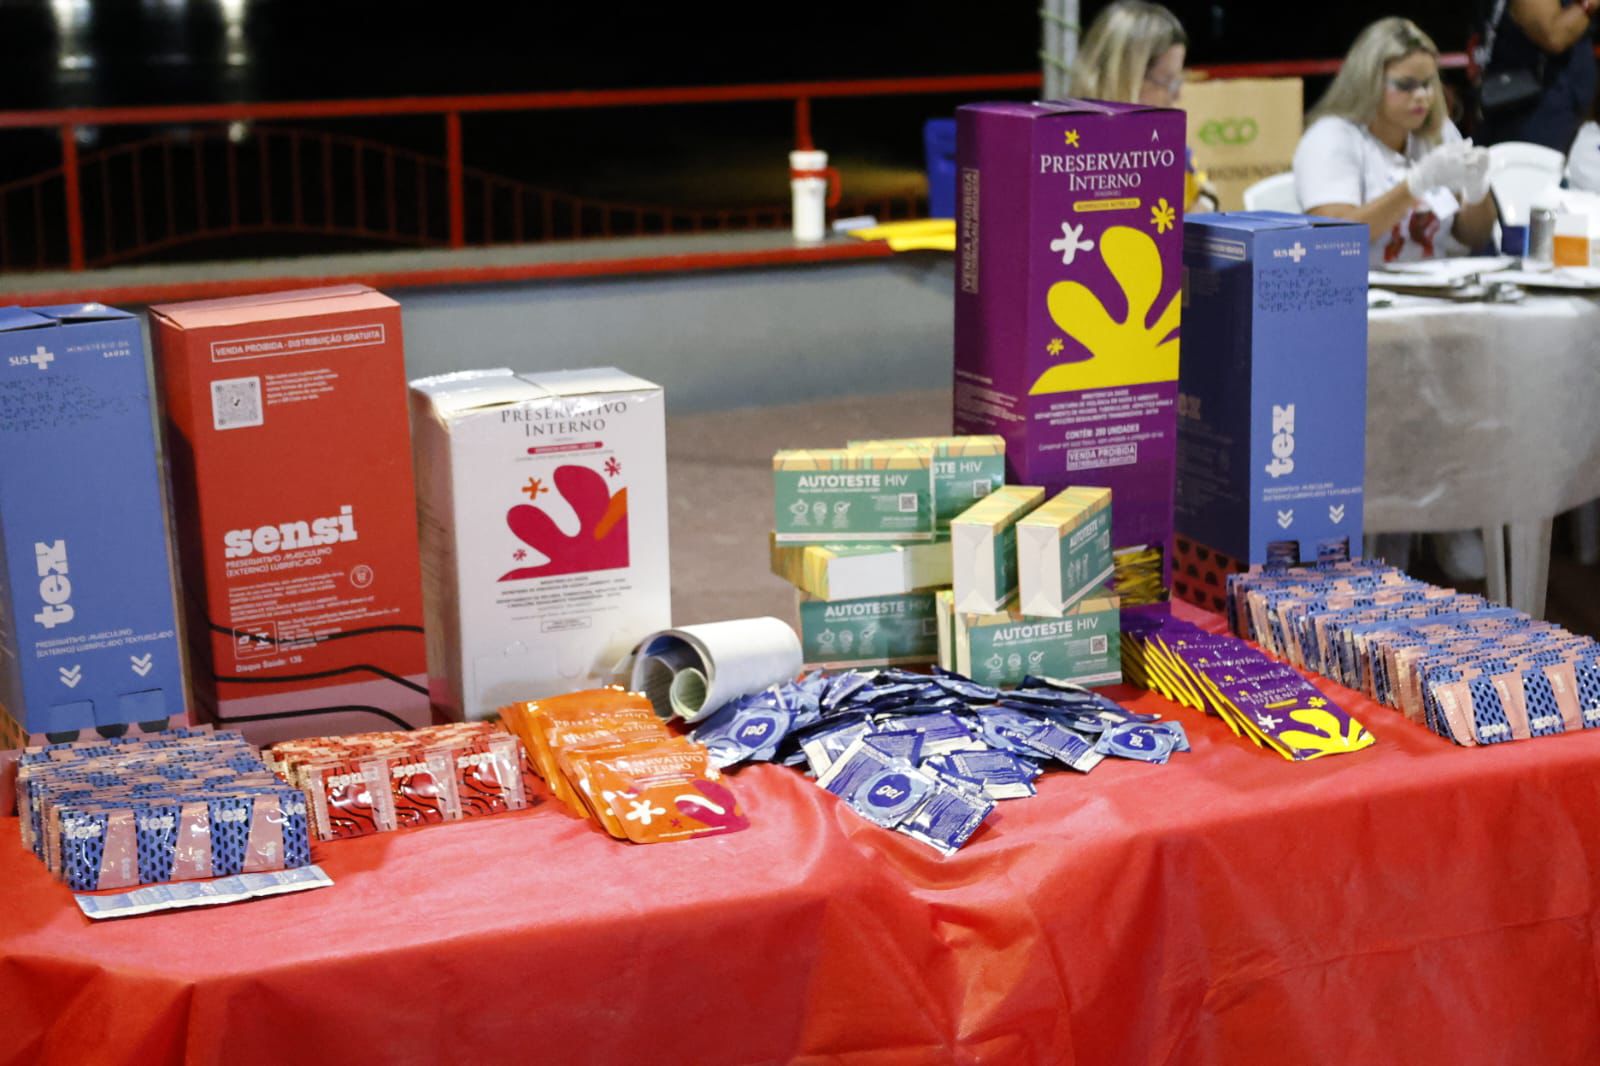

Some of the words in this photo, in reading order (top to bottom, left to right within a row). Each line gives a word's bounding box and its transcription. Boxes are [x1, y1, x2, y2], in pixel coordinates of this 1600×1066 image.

[1040, 149, 1175, 174] PRESERVATIVO
[1069, 172, 1142, 192] INTERNO
[215, 345, 244, 357] VENDA
[244, 341, 283, 354] PROIBIDA
[288, 333, 342, 349] DISTRIBUIÇÃO
[343, 330, 381, 342] GRATUITA
[8, 355, 29, 367] SUS
[525, 418, 606, 437] INTERNO
[1065, 428, 1093, 440] CONTÉM
[1107, 423, 1140, 435] UNIDADES
[1265, 404, 1296, 478] tex
[1069, 450, 1097, 462] VENDA
[1098, 446, 1135, 459] PROIBIDA
[960, 461, 983, 473] HIV
[797, 474, 881, 489] AUTOTESTE
[885, 474, 908, 487] HIV
[224, 505, 358, 558] sensi
[225, 554, 281, 569] PRESERVATIVO
[283, 547, 333, 561] MASCULINO
[34, 540, 74, 629] tex
[824, 601, 905, 617] AUTOTESTE
[992, 620, 1073, 642] AUTOTESTE
[1077, 617, 1099, 632] HIV
[235, 661, 262, 673] Disque
[875, 784, 904, 800] gel
